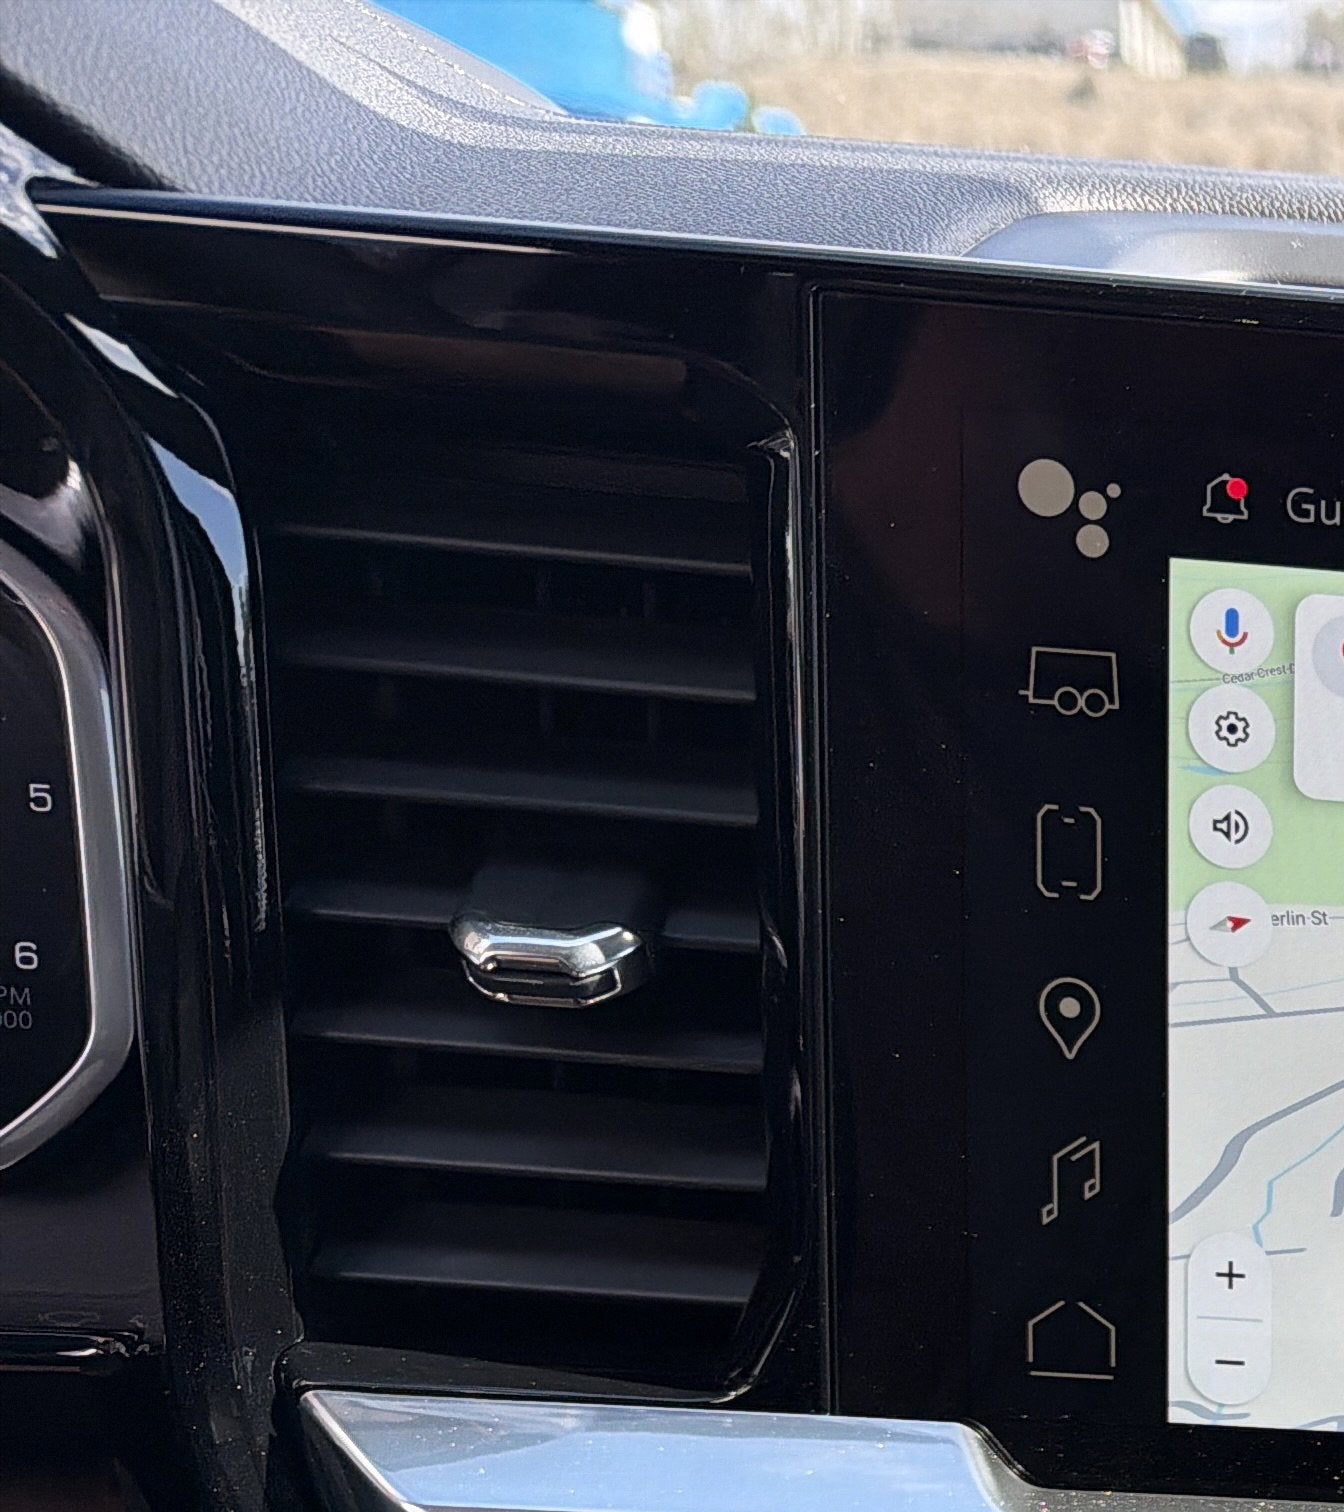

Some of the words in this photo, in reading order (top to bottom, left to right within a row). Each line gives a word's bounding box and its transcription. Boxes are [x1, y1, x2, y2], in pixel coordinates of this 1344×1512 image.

[1222, 668, 1256, 686] Cedar
[1257, 664, 1289, 680] Crest
[28, 783, 53, 812] 5
[1310, 909, 1329, 926] St
[14, 942, 39, 970] 6
